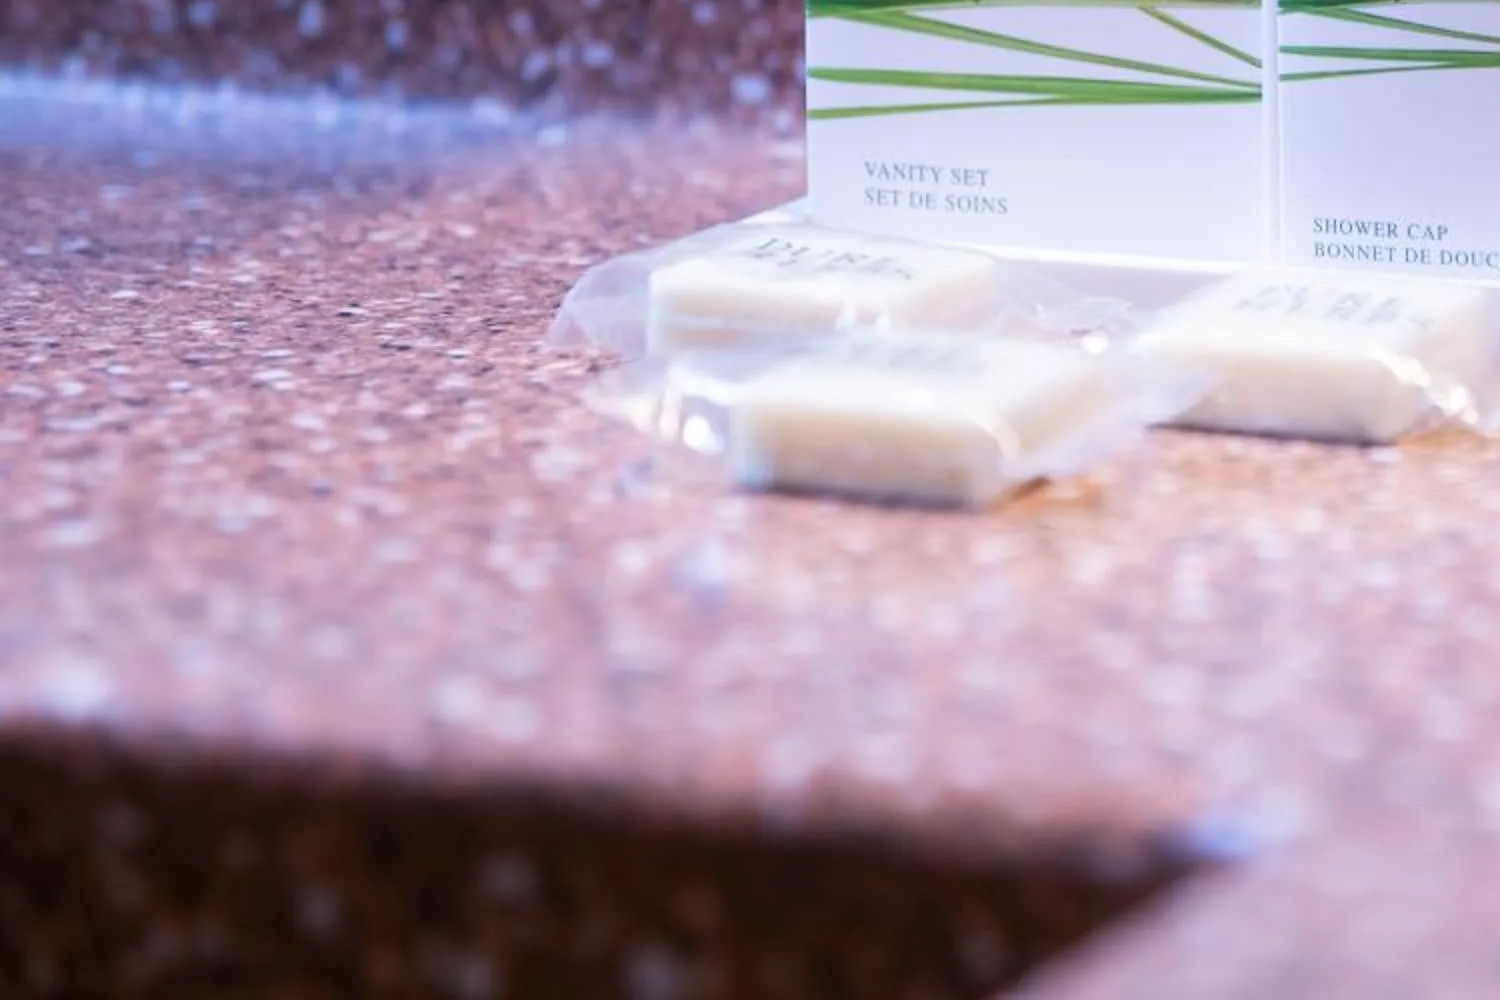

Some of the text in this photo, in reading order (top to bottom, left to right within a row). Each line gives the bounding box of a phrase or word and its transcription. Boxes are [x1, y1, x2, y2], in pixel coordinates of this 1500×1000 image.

[864, 160, 989, 187] VANITY SET
[864, 187, 1009, 215] SET DE SOINS
[1312, 217, 1449, 241] SHOWER CAP
[1313, 241, 1397, 263] BONNET
[1404, 247, 1432, 265] DE
